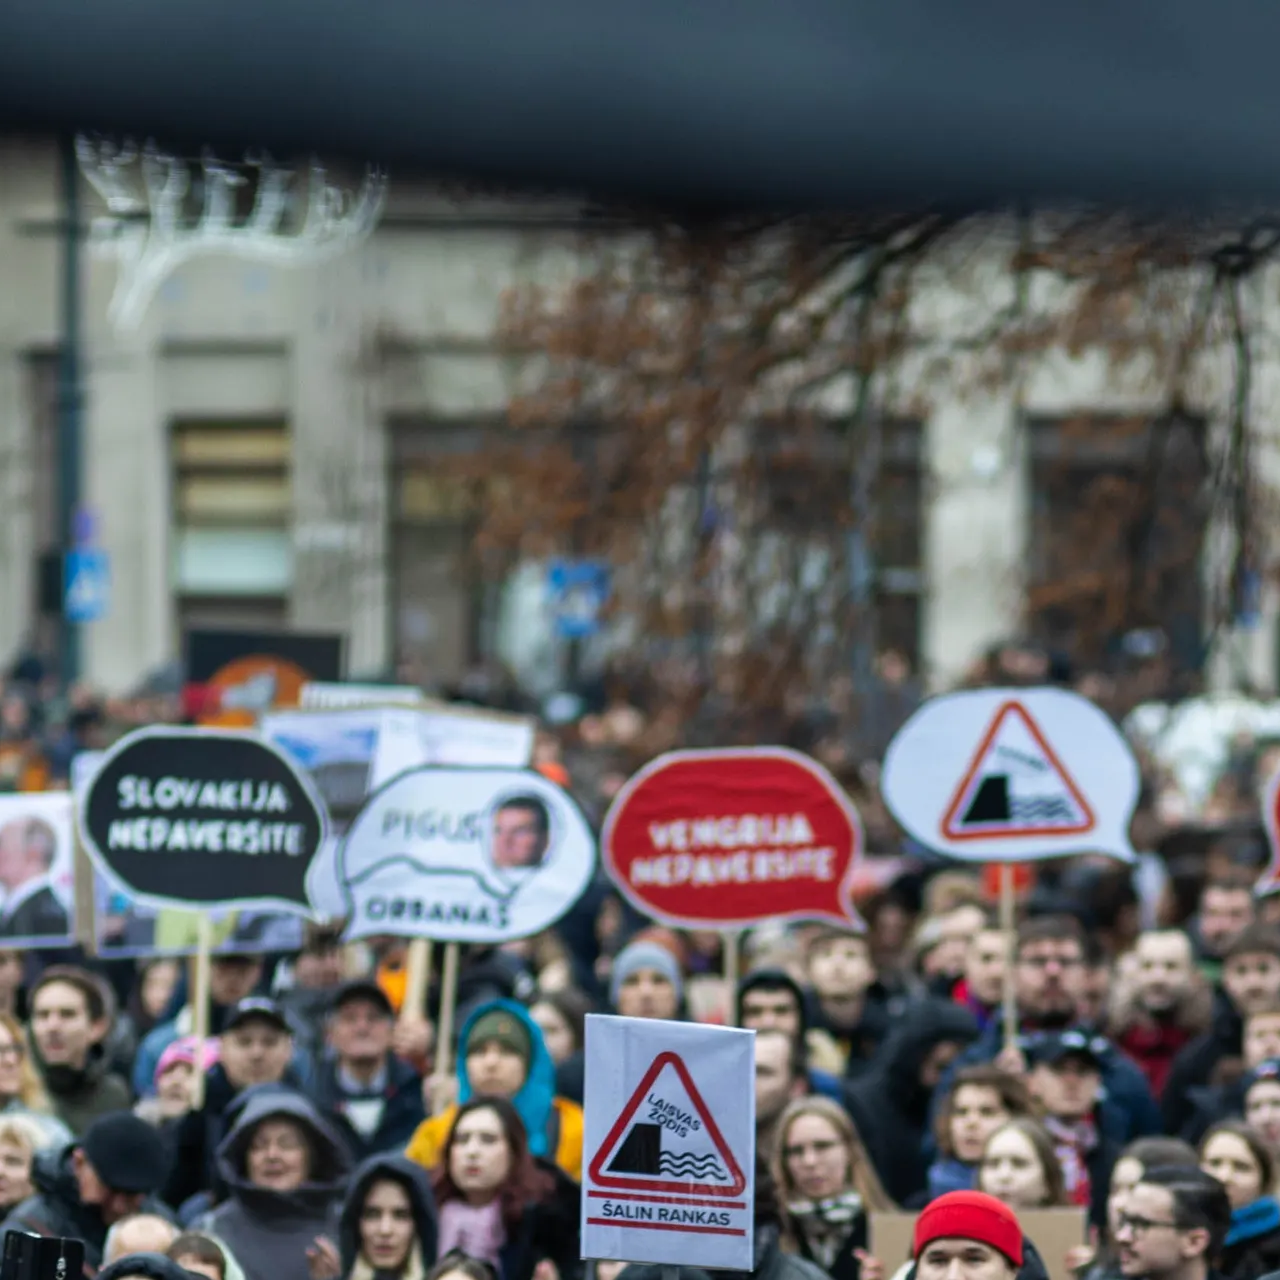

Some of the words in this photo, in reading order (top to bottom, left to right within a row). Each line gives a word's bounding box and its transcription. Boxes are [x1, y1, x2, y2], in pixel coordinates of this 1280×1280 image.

[117, 774, 290, 813] SLOVAKIJA
[107, 816, 306, 856] NEPAVERSITE
[381, 807, 483, 842] PIGUS
[648, 813, 815, 851] VENGRIJA
[366, 895, 510, 929] ORBANAS
[647, 1093, 702, 1132] LAISVAS
[602, 1200, 652, 1220] ŠALIN
[658, 1207, 731, 1226] RANKAS
